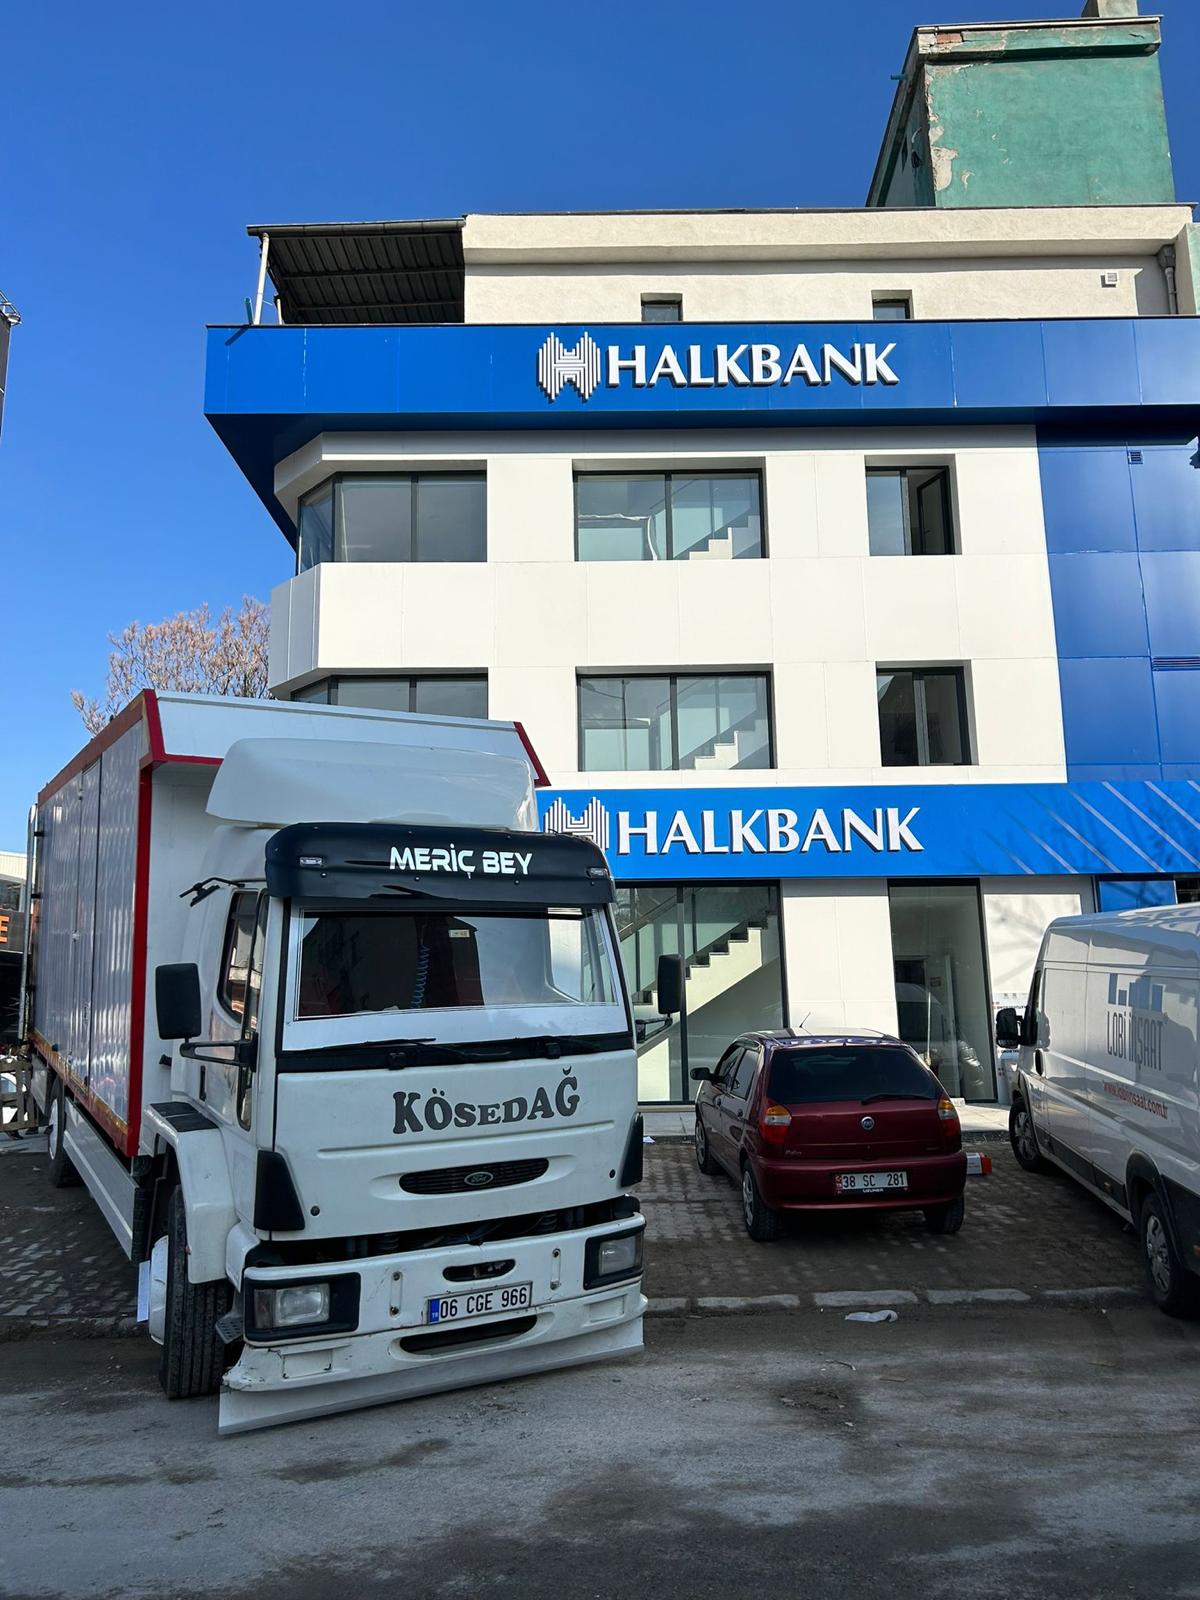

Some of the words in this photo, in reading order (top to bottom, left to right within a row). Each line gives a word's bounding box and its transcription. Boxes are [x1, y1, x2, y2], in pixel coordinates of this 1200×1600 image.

[607, 342, 900, 387] HALKBANK
[617, 807, 925, 855] HALKBANK
[389, 843, 476, 879] MERİÇ
[482, 851, 533, 875] BEY
[393, 1066, 581, 1135] KÖSEDAĞ
[842, 1175, 856, 1188] 38
[862, 1174, 876, 1187] SC
[887, 1173, 905, 1186] 281
[440, 1299, 458, 1318] 06
[466, 1293, 493, 1314] CGE
[501, 1287, 527, 1307] 966
